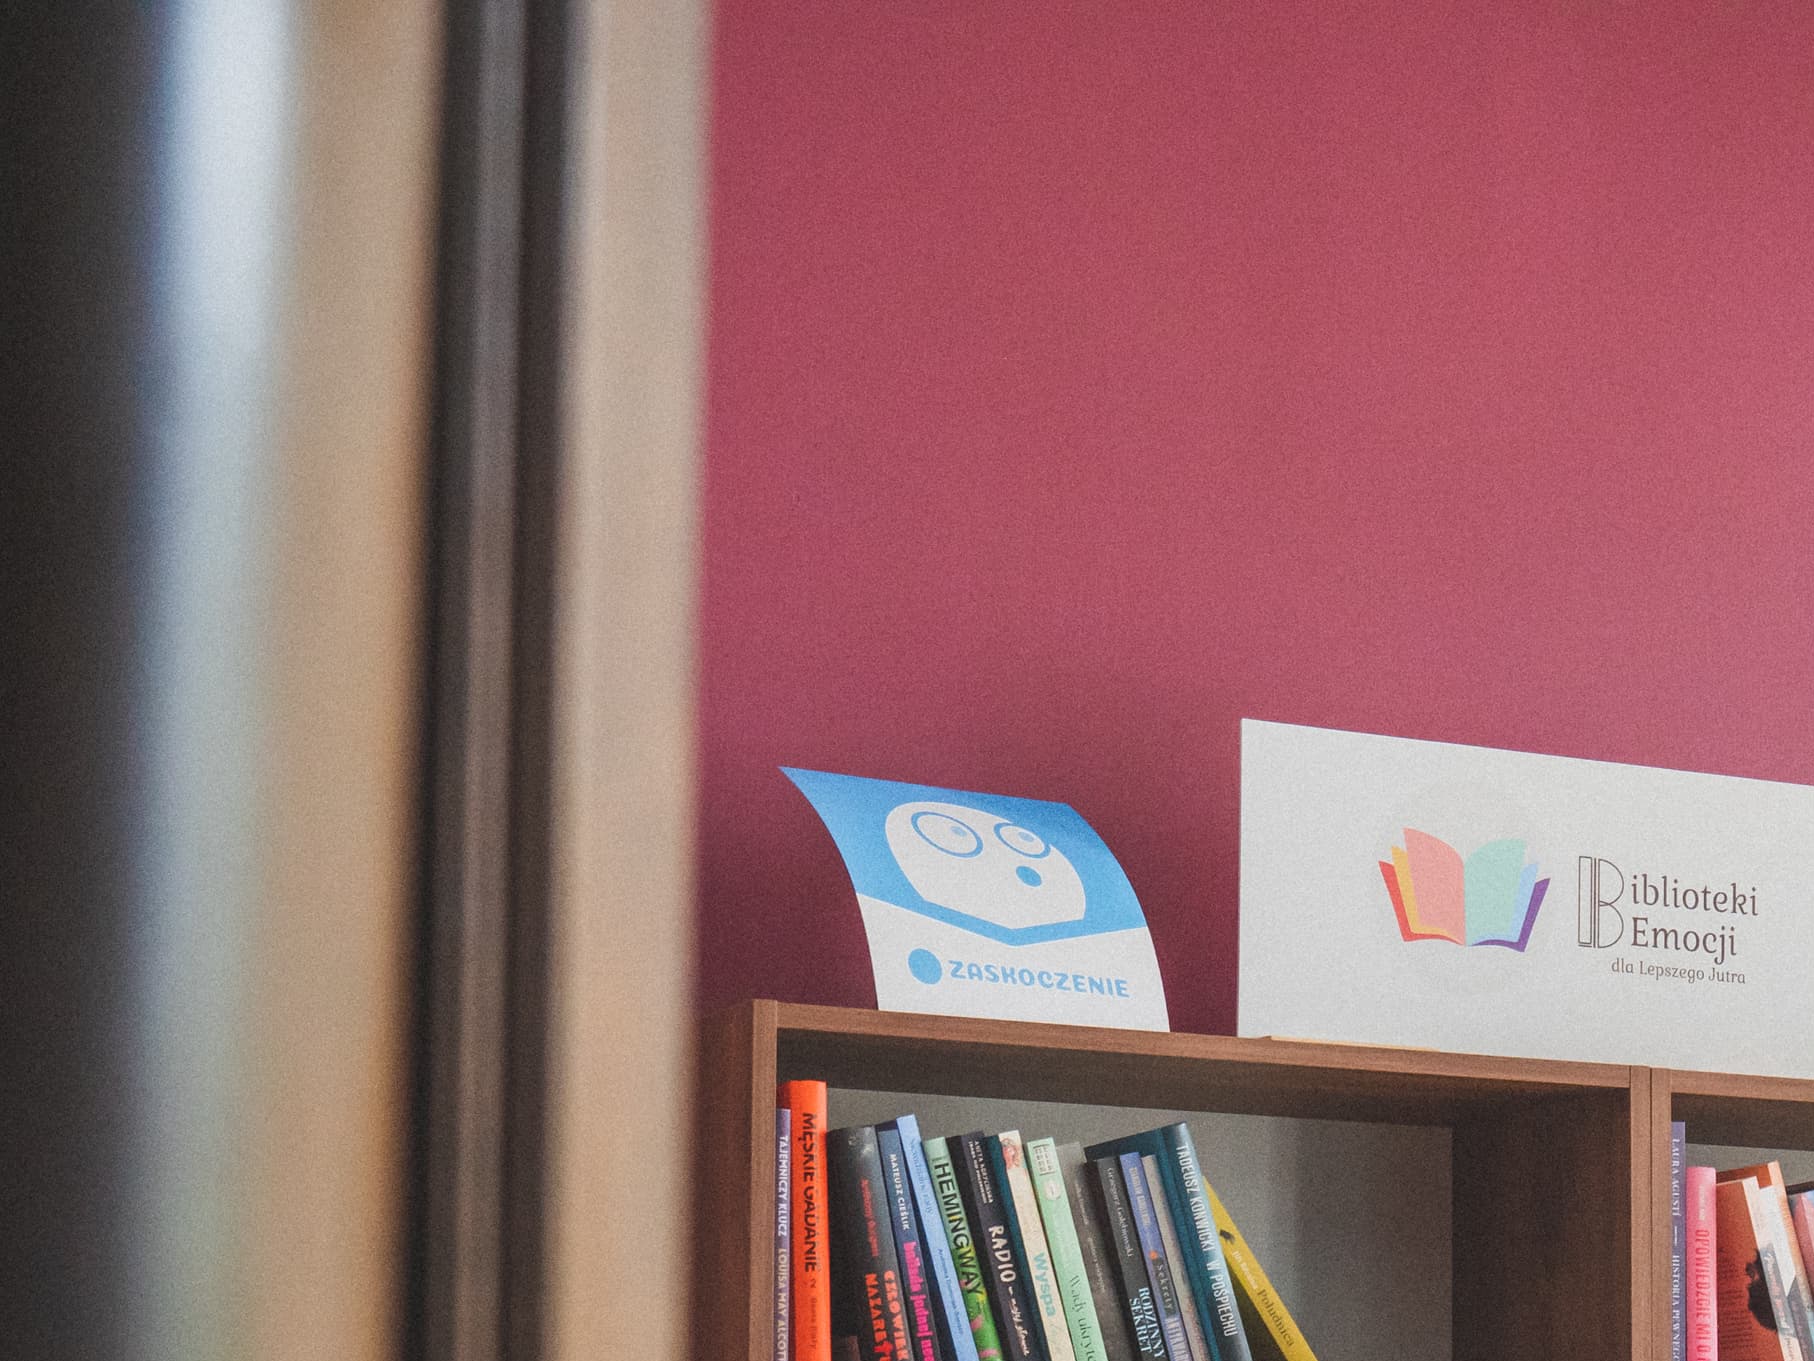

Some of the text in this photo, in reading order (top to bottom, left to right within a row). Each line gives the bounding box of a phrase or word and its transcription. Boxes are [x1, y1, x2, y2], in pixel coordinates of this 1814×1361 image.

[1631, 917, 1737, 964] Emocji
[948, 960, 1131, 998] ZASKOCZENIE
[1611, 957, 1746, 984] dla Lepszego Jutra
[778, 1135, 790, 1200] TAJEMNICZY
[890, 1154, 903, 1196] MATEUSZ
[1672, 1138, 1681, 1175] LAURA
[778, 1203, 788, 1237] KLUCZ
[934, 1162, 985, 1296] HEMINGWAY
[1175, 1143, 1238, 1337] TADEUSZ KONWICKI W POŚPIECHU
[778, 1247, 789, 1290] LOUISA
[988, 1225, 1016, 1282] RADIO
[1694, 1229, 1710, 1319] OPOWIEDZCIE
[778, 1292, 787, 1316] MAY
[1032, 1251, 1057, 1317] Wyspa
[1672, 1255, 1681, 1307] HISTORIA
[1129, 1298, 1152, 1354] SEKRET
[1137, 1286, 1165, 1358] RODZINNY
